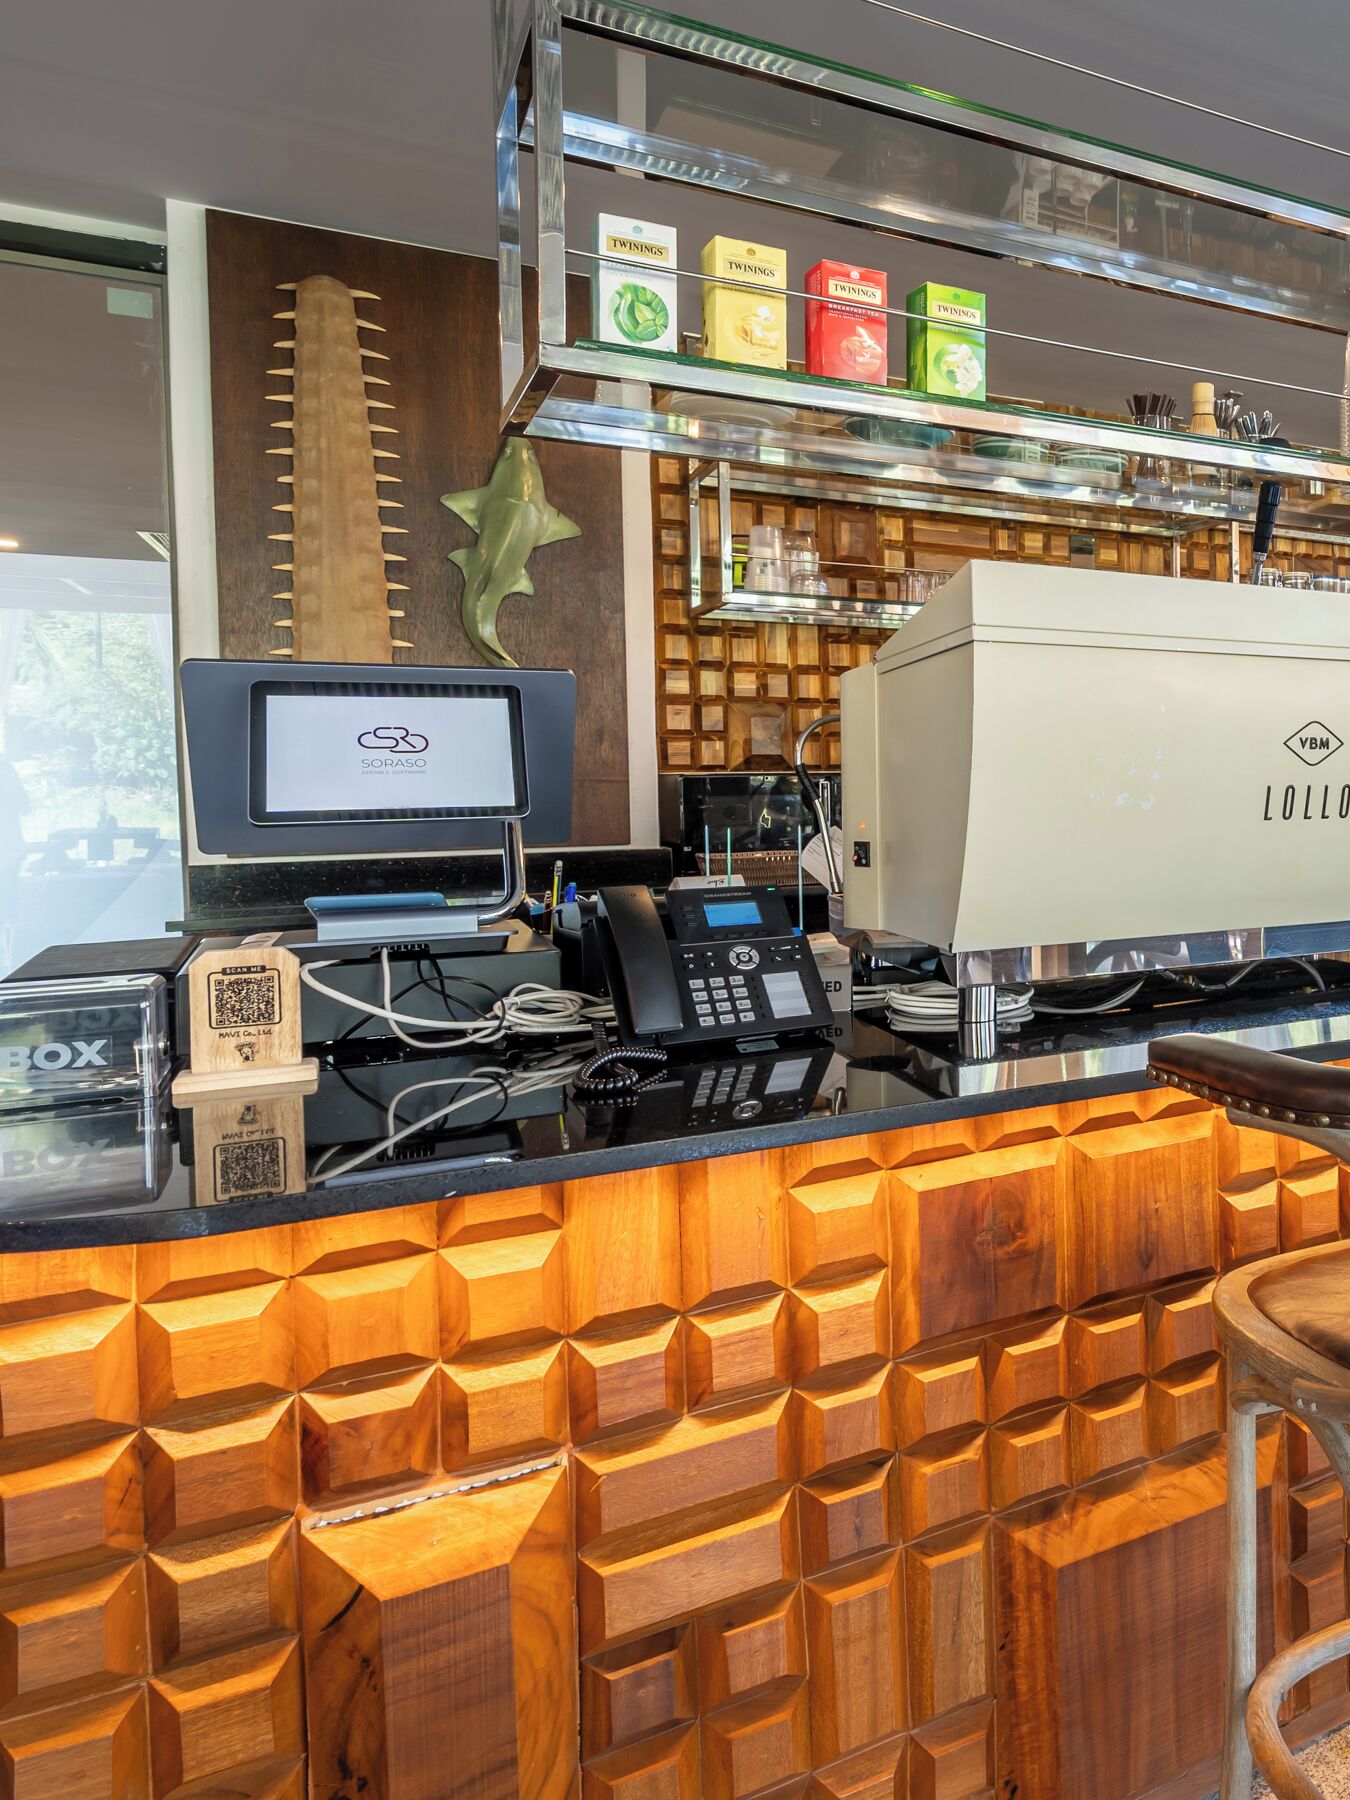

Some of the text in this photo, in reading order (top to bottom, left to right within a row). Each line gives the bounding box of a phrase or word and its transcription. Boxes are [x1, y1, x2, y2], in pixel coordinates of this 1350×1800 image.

[611, 238, 664, 257] TWININGS
[728, 261, 776, 278] TWININGS
[833, 283, 877, 299] TWININGS
[828, 303, 865, 315] BREAKFAST
[936, 304, 976, 320] TWININGS
[1299, 736, 1330, 750] VBM
[361, 758, 427, 768] SORASO
[218, 1030, 241, 1039] MAVI
[0, 1039, 109, 1073] BOX
